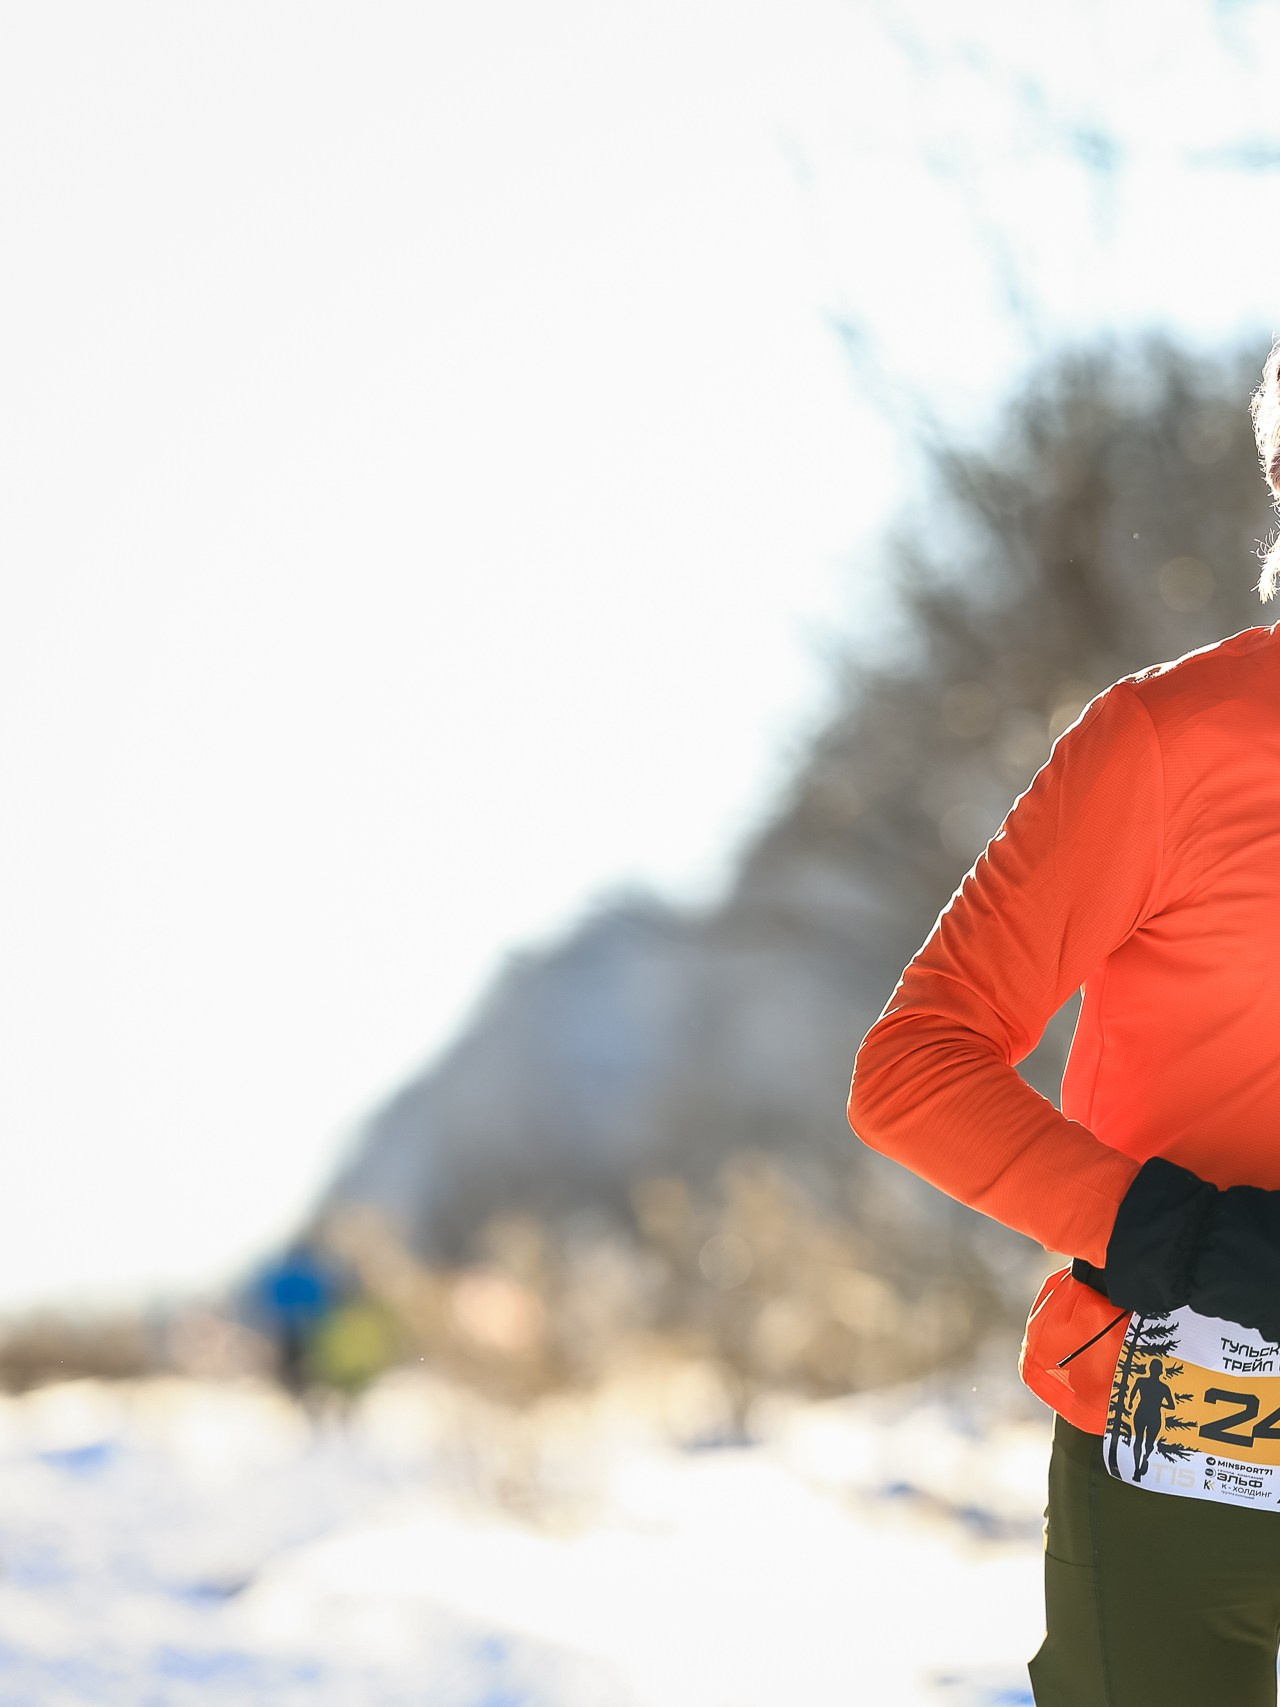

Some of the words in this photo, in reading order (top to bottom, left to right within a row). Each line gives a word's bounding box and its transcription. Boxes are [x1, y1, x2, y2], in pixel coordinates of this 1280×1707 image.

[1222, 1357, 1274, 1372] ТРЕЙЛ
[1152, 1462, 1195, 1489] T15
[1217, 1460, 1274, 1476] MINSPORT71
[1217, 1473, 1263, 1488] ЭЛЬФ
[1232, 1486, 1273, 1498] ХОЛДИНГ
